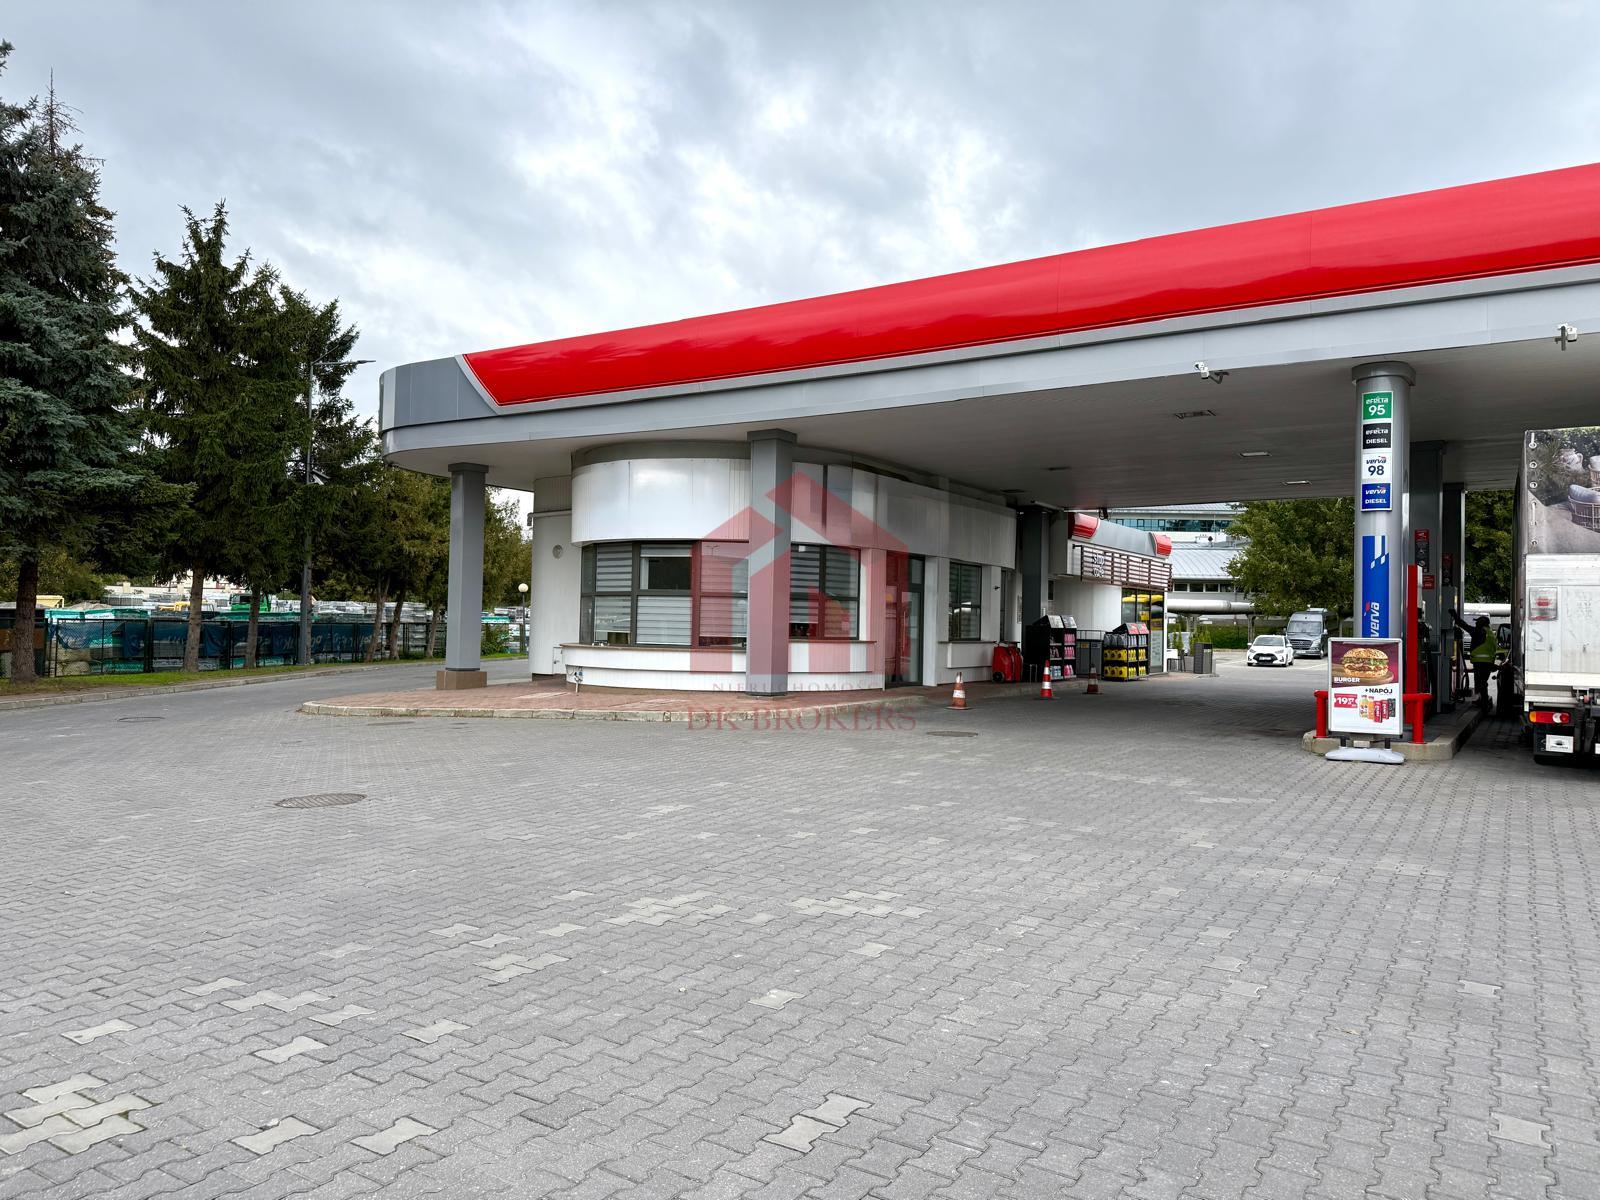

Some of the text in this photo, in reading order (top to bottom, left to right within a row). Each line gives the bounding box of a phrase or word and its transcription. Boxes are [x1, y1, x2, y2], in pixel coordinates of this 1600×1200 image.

[1368, 405, 1386, 416] 95
[1368, 465, 1384, 476] 98
[1370, 602, 1380, 638] verva
